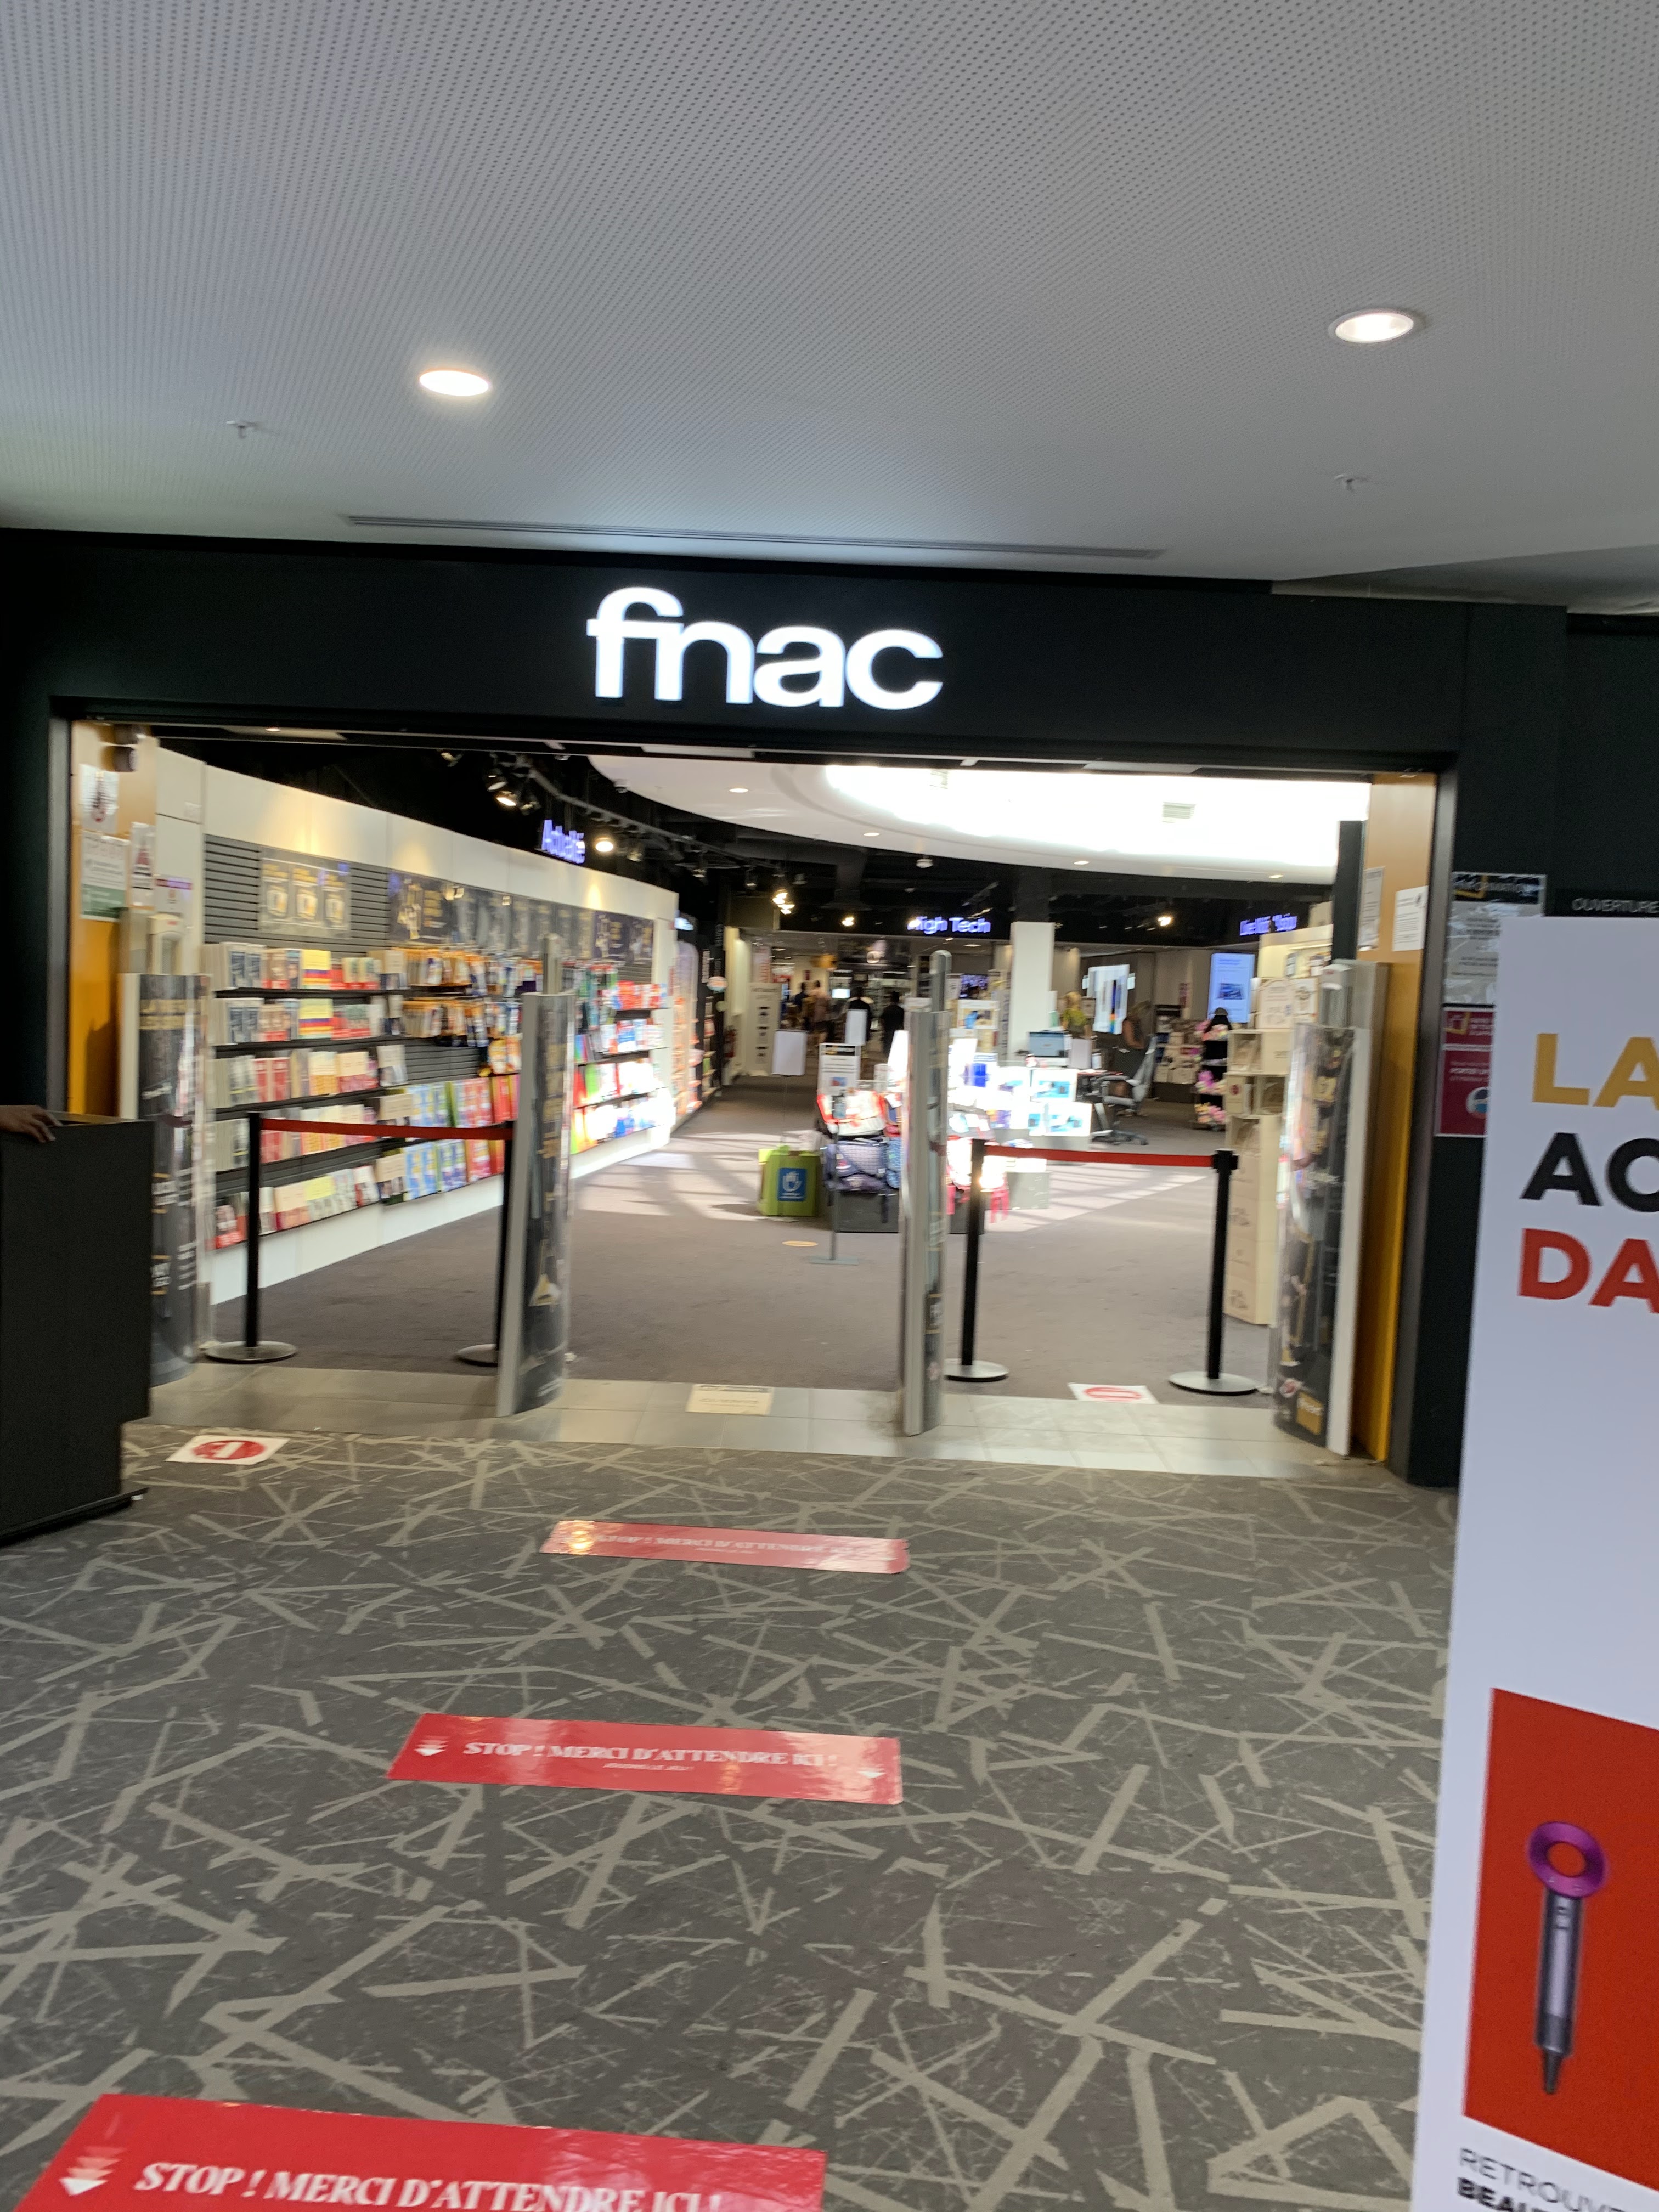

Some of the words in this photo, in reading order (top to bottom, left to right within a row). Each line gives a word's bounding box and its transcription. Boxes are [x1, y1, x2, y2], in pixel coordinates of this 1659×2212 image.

[586, 586, 943, 710] fnac
[949, 917, 991, 933] Tech
[462, 1742, 532, 1756] STOP
[546, 1745, 627, 1759] MERCI
[632, 1748, 789, 1765] D'ATTENDRE
[133, 2162, 245, 2195] STOP
[263, 2170, 397, 2206] MERCI
[396, 2178, 645, 2212] D'ATTENDRE
[1457, 2176, 1551, 2212] BEA
[1460, 2147, 1626, 2212] RETROUV
